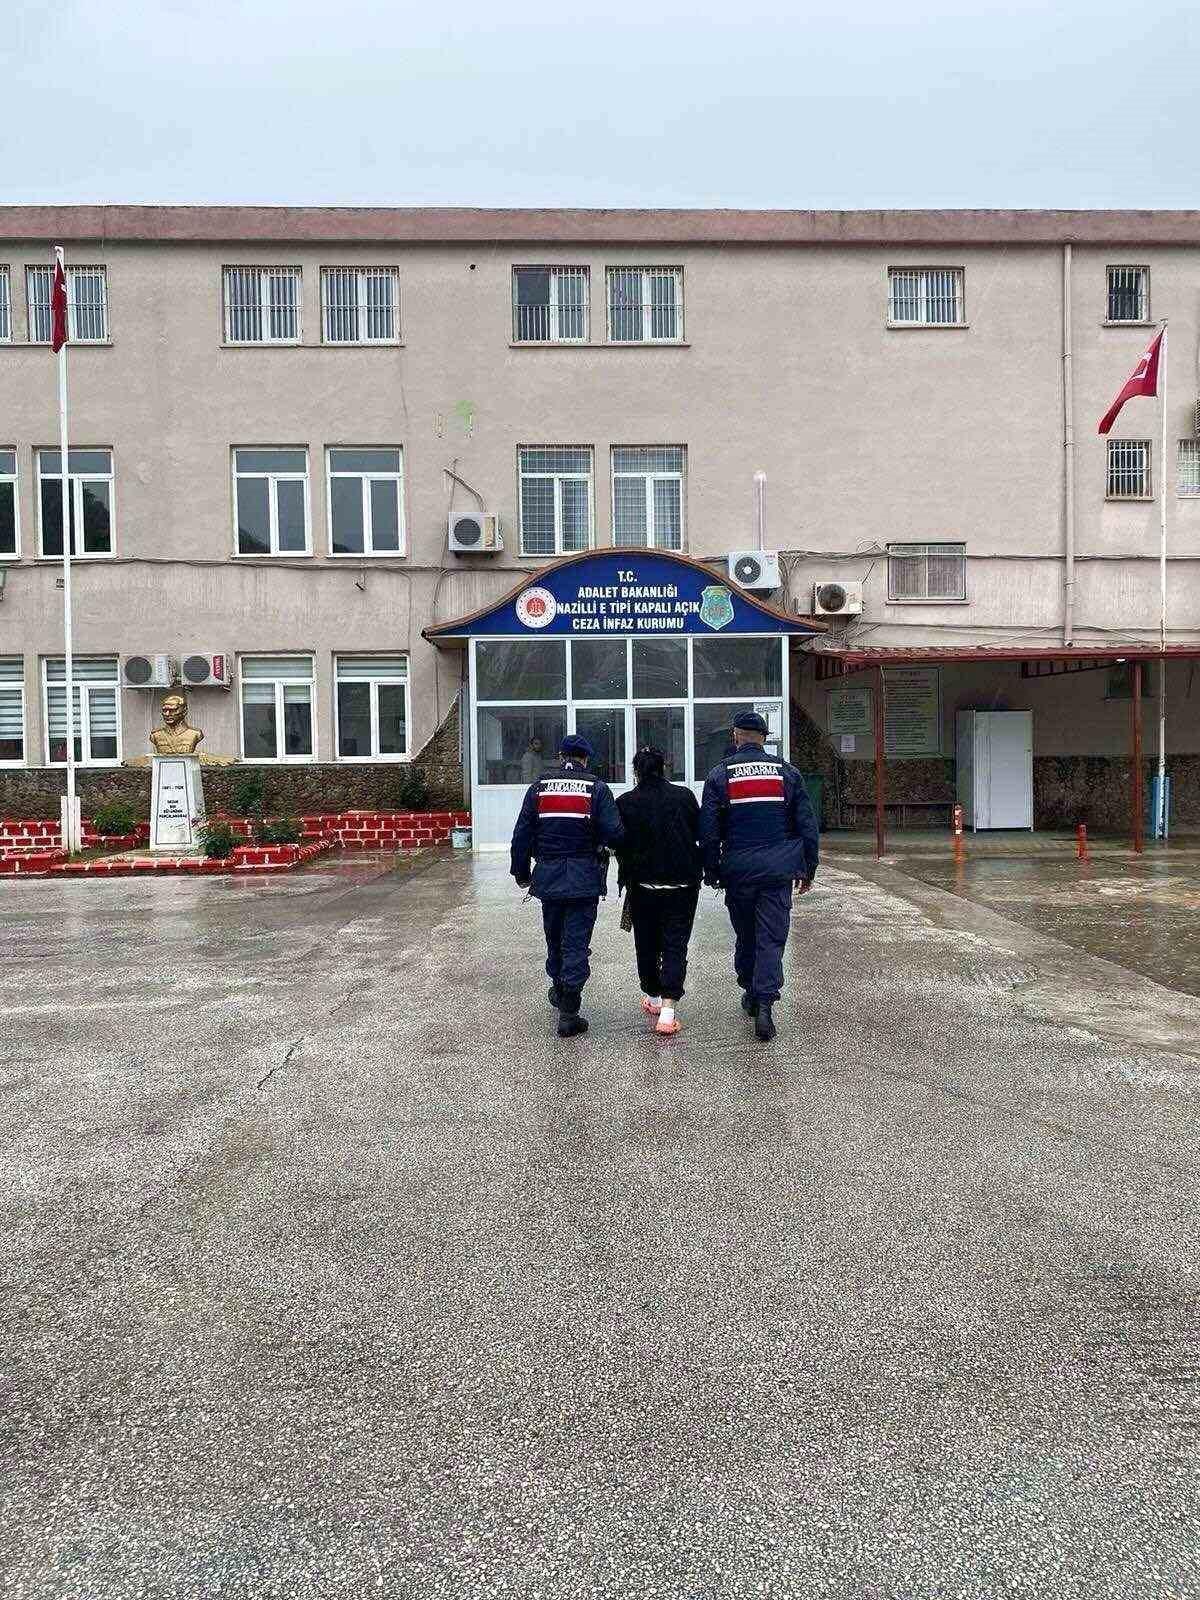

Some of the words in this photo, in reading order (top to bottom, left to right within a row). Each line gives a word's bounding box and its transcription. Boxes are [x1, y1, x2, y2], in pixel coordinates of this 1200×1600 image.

[617, 570, 638, 583] T.C.
[577, 586, 619, 599] ADALET
[621, 584, 678, 599] BAKANLIĞI
[556, 600, 597, 615] NAZİLLİ
[600, 602, 607, 614] E
[608, 599, 633, 615] TİPİ
[634, 602, 672, 615] KAPALI
[674, 602, 700, 616] AÇIK
[572, 618, 600, 630] CEZA
[603, 615, 634, 630] İNFAZ
[637, 616, 685, 630] KURUMU
[733, 763, 779, 777] JANDARMA
